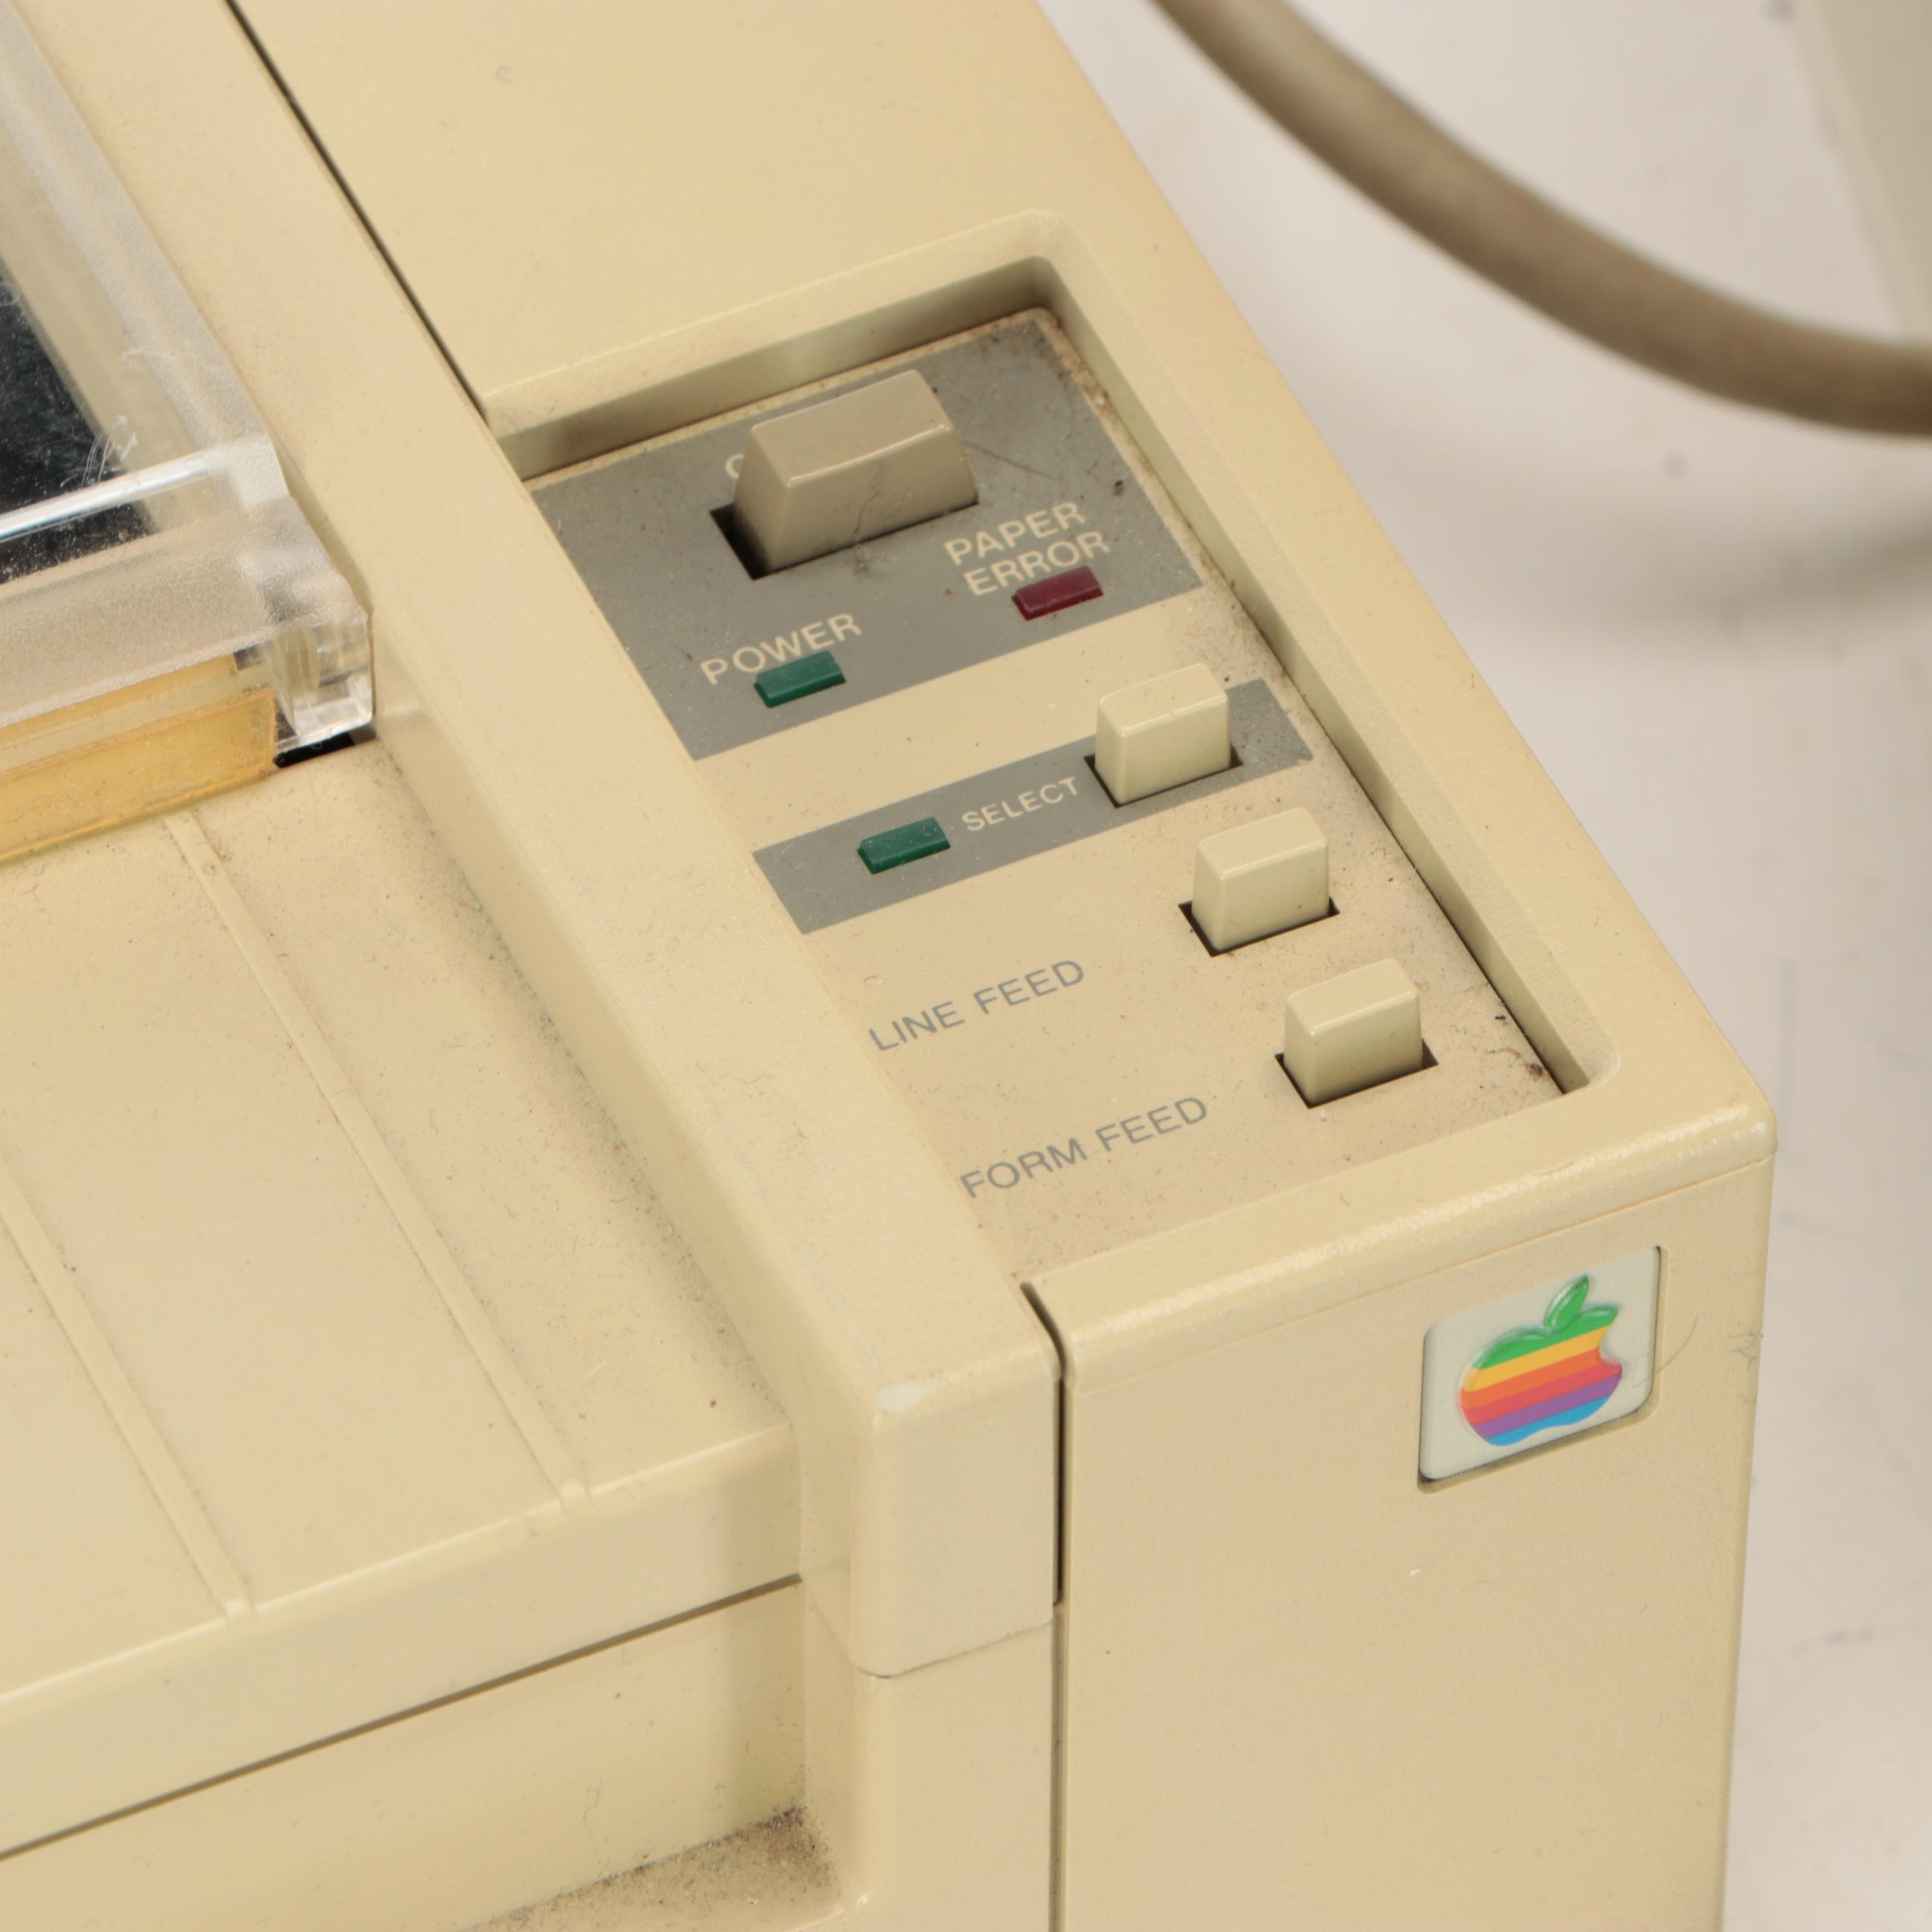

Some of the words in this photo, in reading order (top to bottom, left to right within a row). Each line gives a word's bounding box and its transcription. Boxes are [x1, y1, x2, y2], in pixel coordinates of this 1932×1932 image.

[944, 501, 1086, 565] PAPER
[964, 530, 1110, 596] ERROR
[700, 613, 863, 686] POWER
[962, 776, 1080, 833] SELECT
[869, 1002, 965, 1052] LINE
[973, 959, 1085, 1015] FEED
[960, 1138, 1087, 1199] FORM
[1095, 1096, 1208, 1152] FEED
